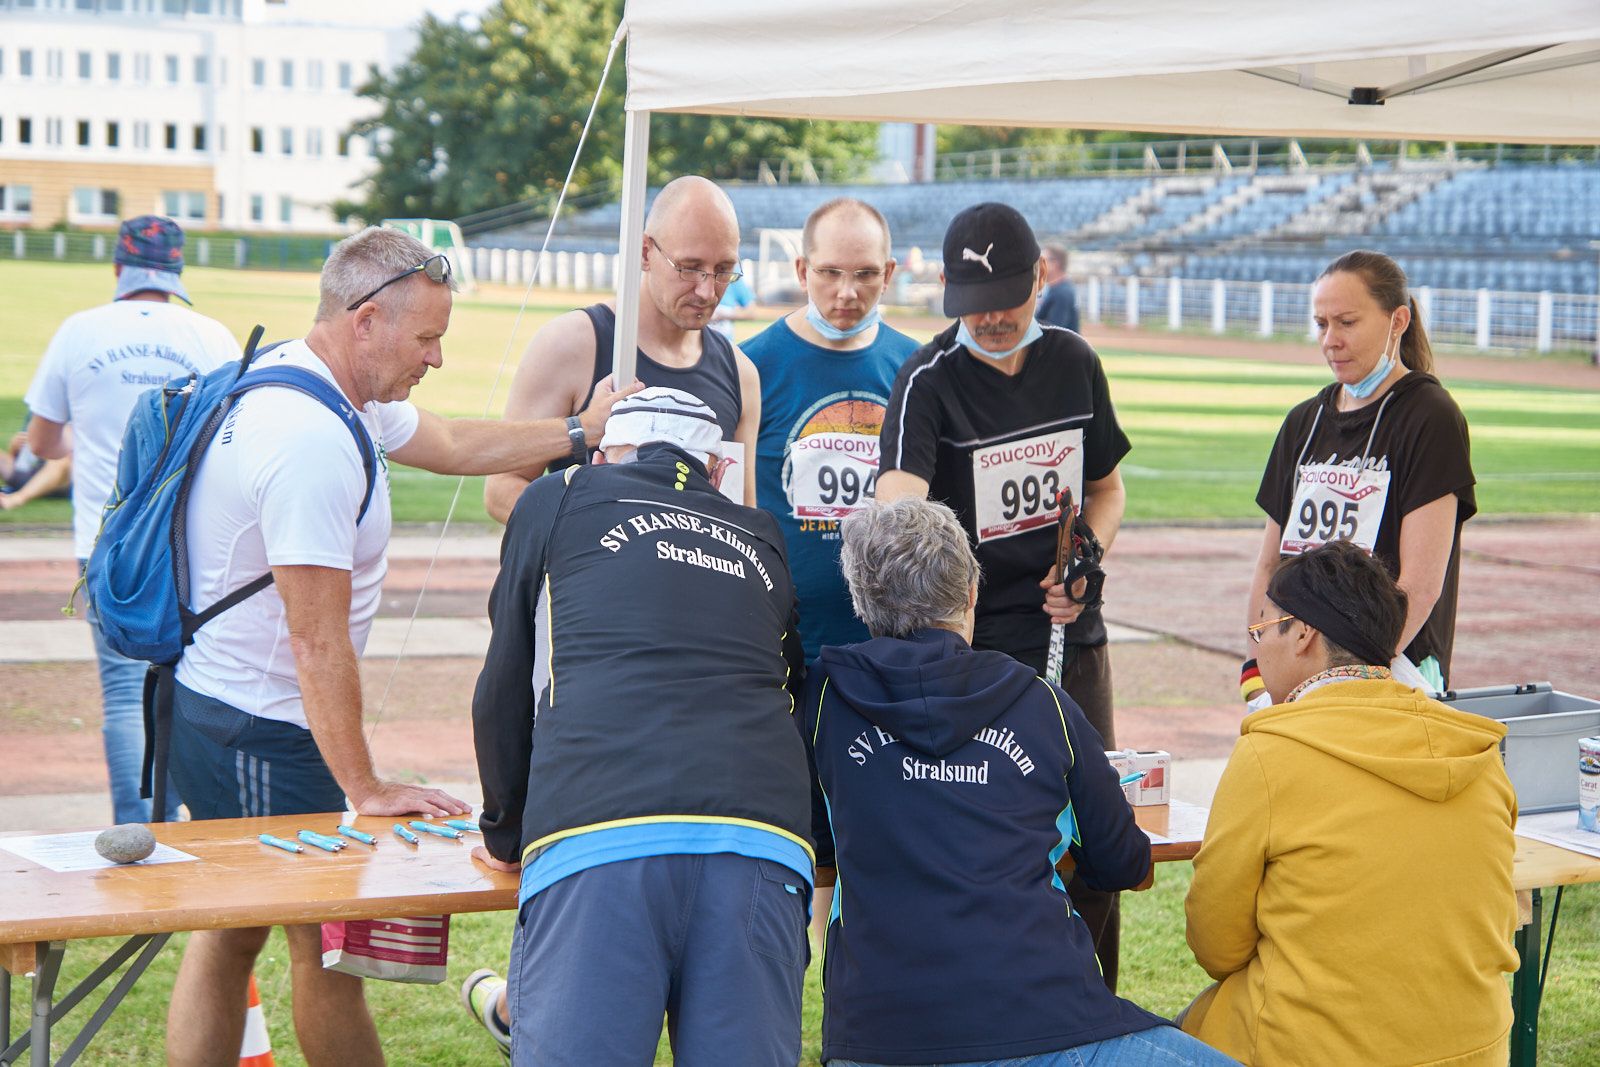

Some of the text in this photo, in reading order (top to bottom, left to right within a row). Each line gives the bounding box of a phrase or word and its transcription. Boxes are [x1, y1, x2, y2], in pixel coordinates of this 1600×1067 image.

[88, 358, 104, 373] SV
[121, 371, 171, 385] Stralsund
[800, 437, 876, 456] saucony
[980, 440, 1056, 469] saucony
[1001, 470, 1060, 520] 993
[1298, 498, 1359, 541] 995
[600, 512, 774, 592] SV HANSE-Klinikum
[656, 540, 746, 579] Stralsund
[848, 732, 874, 767] SV
[902, 756, 989, 785] Stralsund
